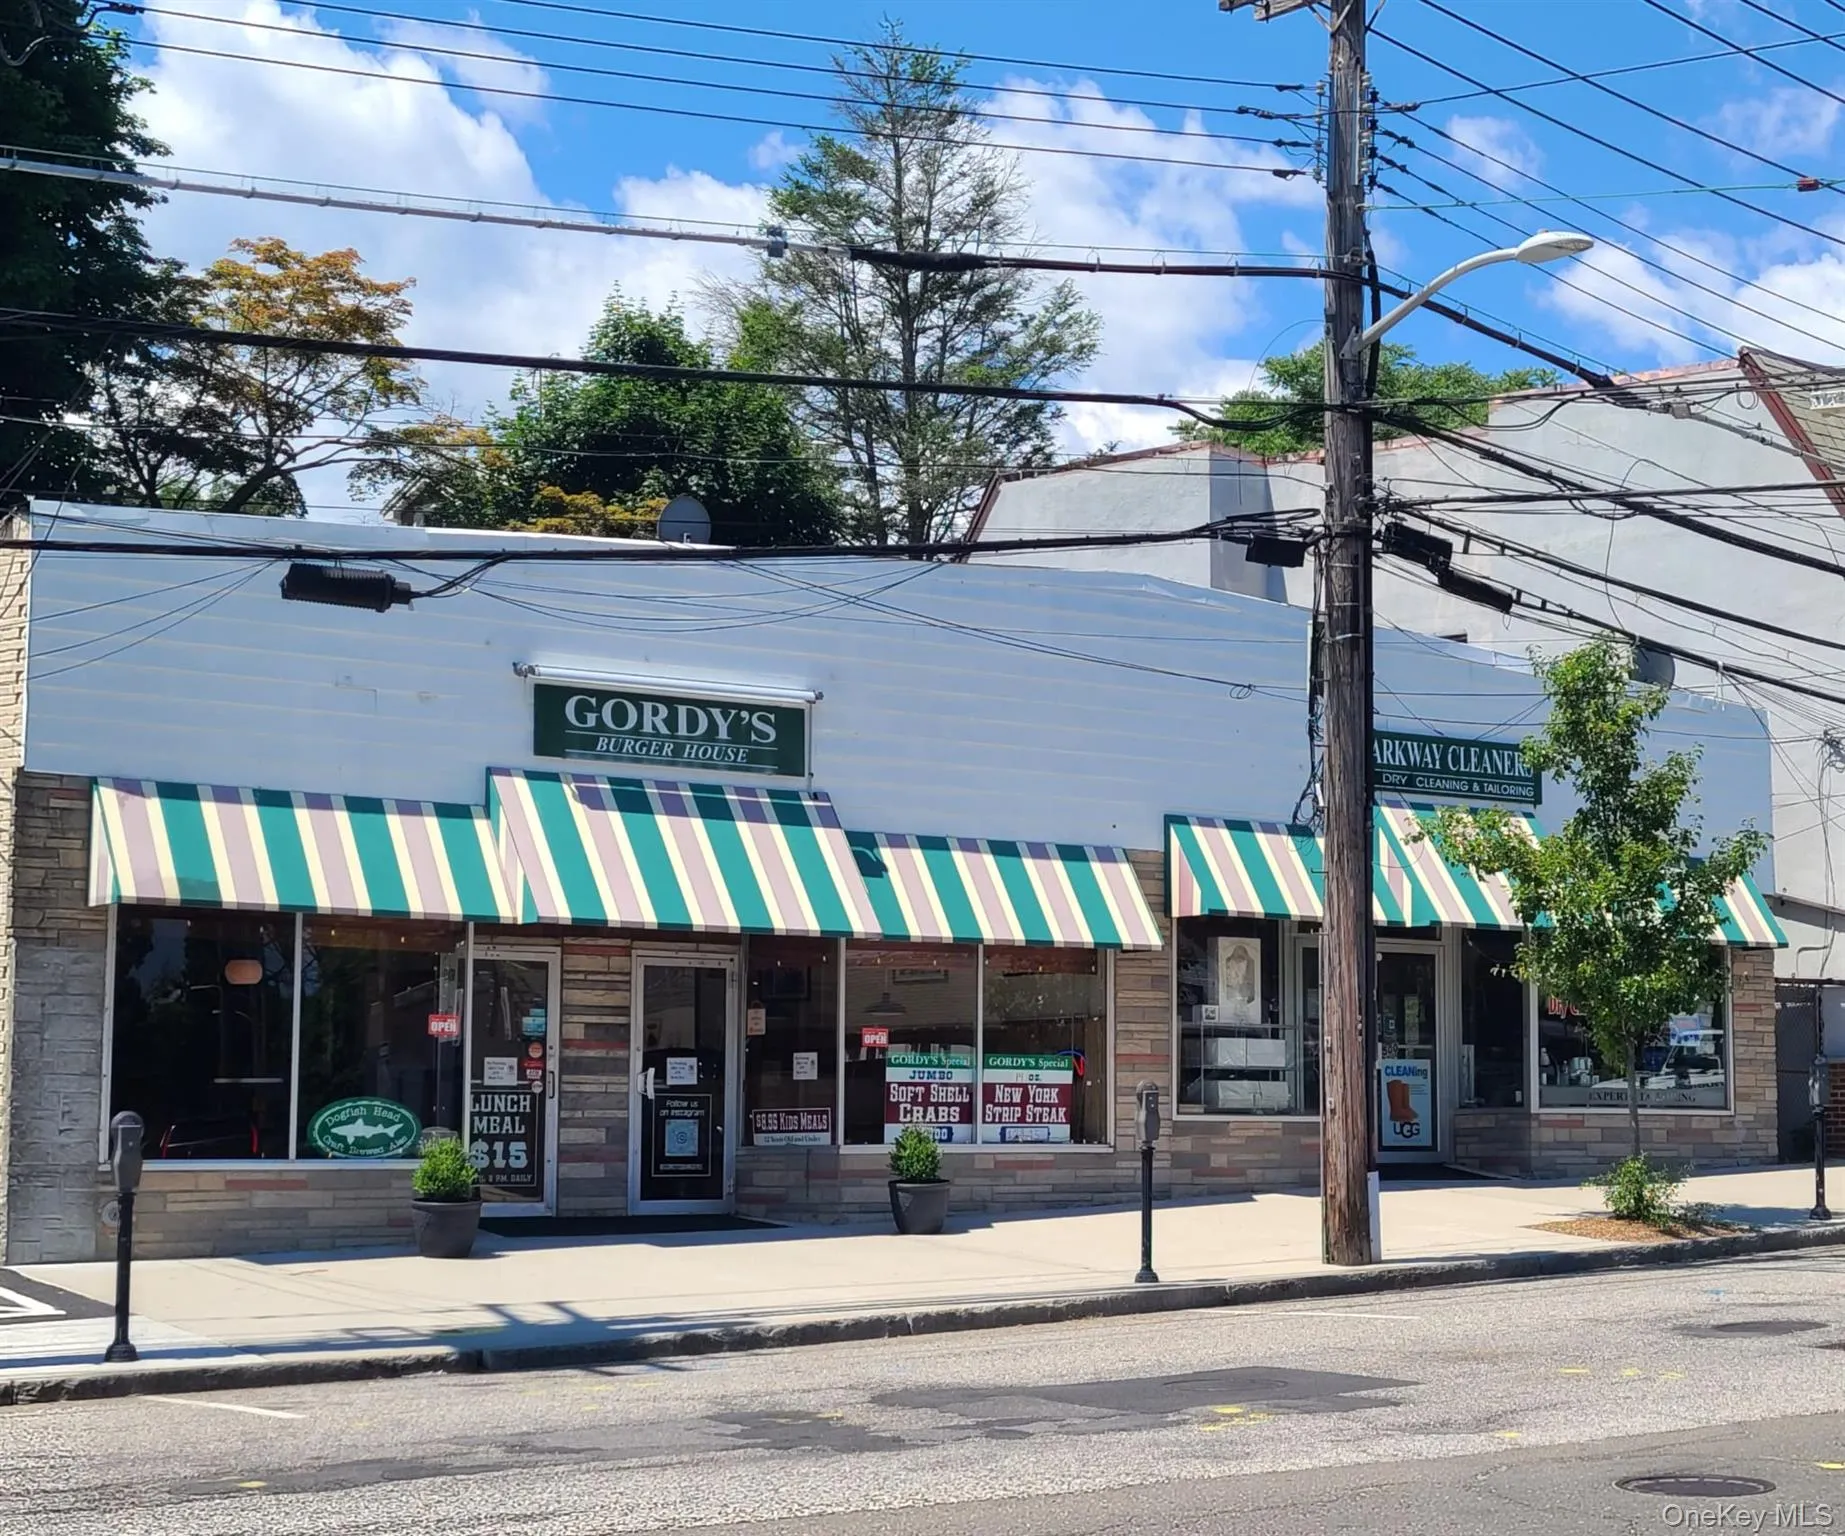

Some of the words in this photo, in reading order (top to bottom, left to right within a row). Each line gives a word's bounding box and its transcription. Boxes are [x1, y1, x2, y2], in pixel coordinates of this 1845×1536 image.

[564, 694, 777, 744] GORDY'S
[595, 737, 674, 757] BURGER
[683, 744, 750, 763] HOUSE
[1373, 738, 1443, 770] ARKWAY
[1382, 772, 1408, 785] DRY
[1416, 776, 1469, 792] CLEANING
[1472, 782, 1480, 793] &
[1483, 782, 1534, 797] TAILORING
[431, 1021, 457, 1033] OPEN
[864, 1034, 888, 1045] OPEN
[891, 1054, 938, 1065] GORDY'S
[941, 1055, 970, 1069] Special
[989, 1057, 1035, 1066] GORDY'S
[1038, 1058, 1068, 1069] Special
[909, 1070, 953, 1080] JUMBO
[1384, 1065, 1428, 1079] CLEANing
[889, 1083, 925, 1102] SOFT
[930, 1083, 970, 1102] SHELL
[994, 1084, 1023, 1103] NEW
[1028, 1084, 1059, 1103] YORK
[470, 1094, 531, 1112] LUNCH
[325, 1106, 367, 1127] Dogfish
[373, 1106, 401, 1122] Head
[779, 1112, 799, 1130] KIDS
[800, 1112, 828, 1130] MEALS
[899, 1103, 961, 1122] CRABS
[985, 1104, 1021, 1122] STRIP
[1026, 1104, 1067, 1123] STEAK
[473, 1116, 526, 1134] MEAL
[1393, 1121, 1420, 1139] UGG
[323, 1135, 345, 1152] Craft
[349, 1146, 384, 1155] Brewed
[469, 1138, 529, 1171] $15
[510, 1173, 532, 1183] DAILY
